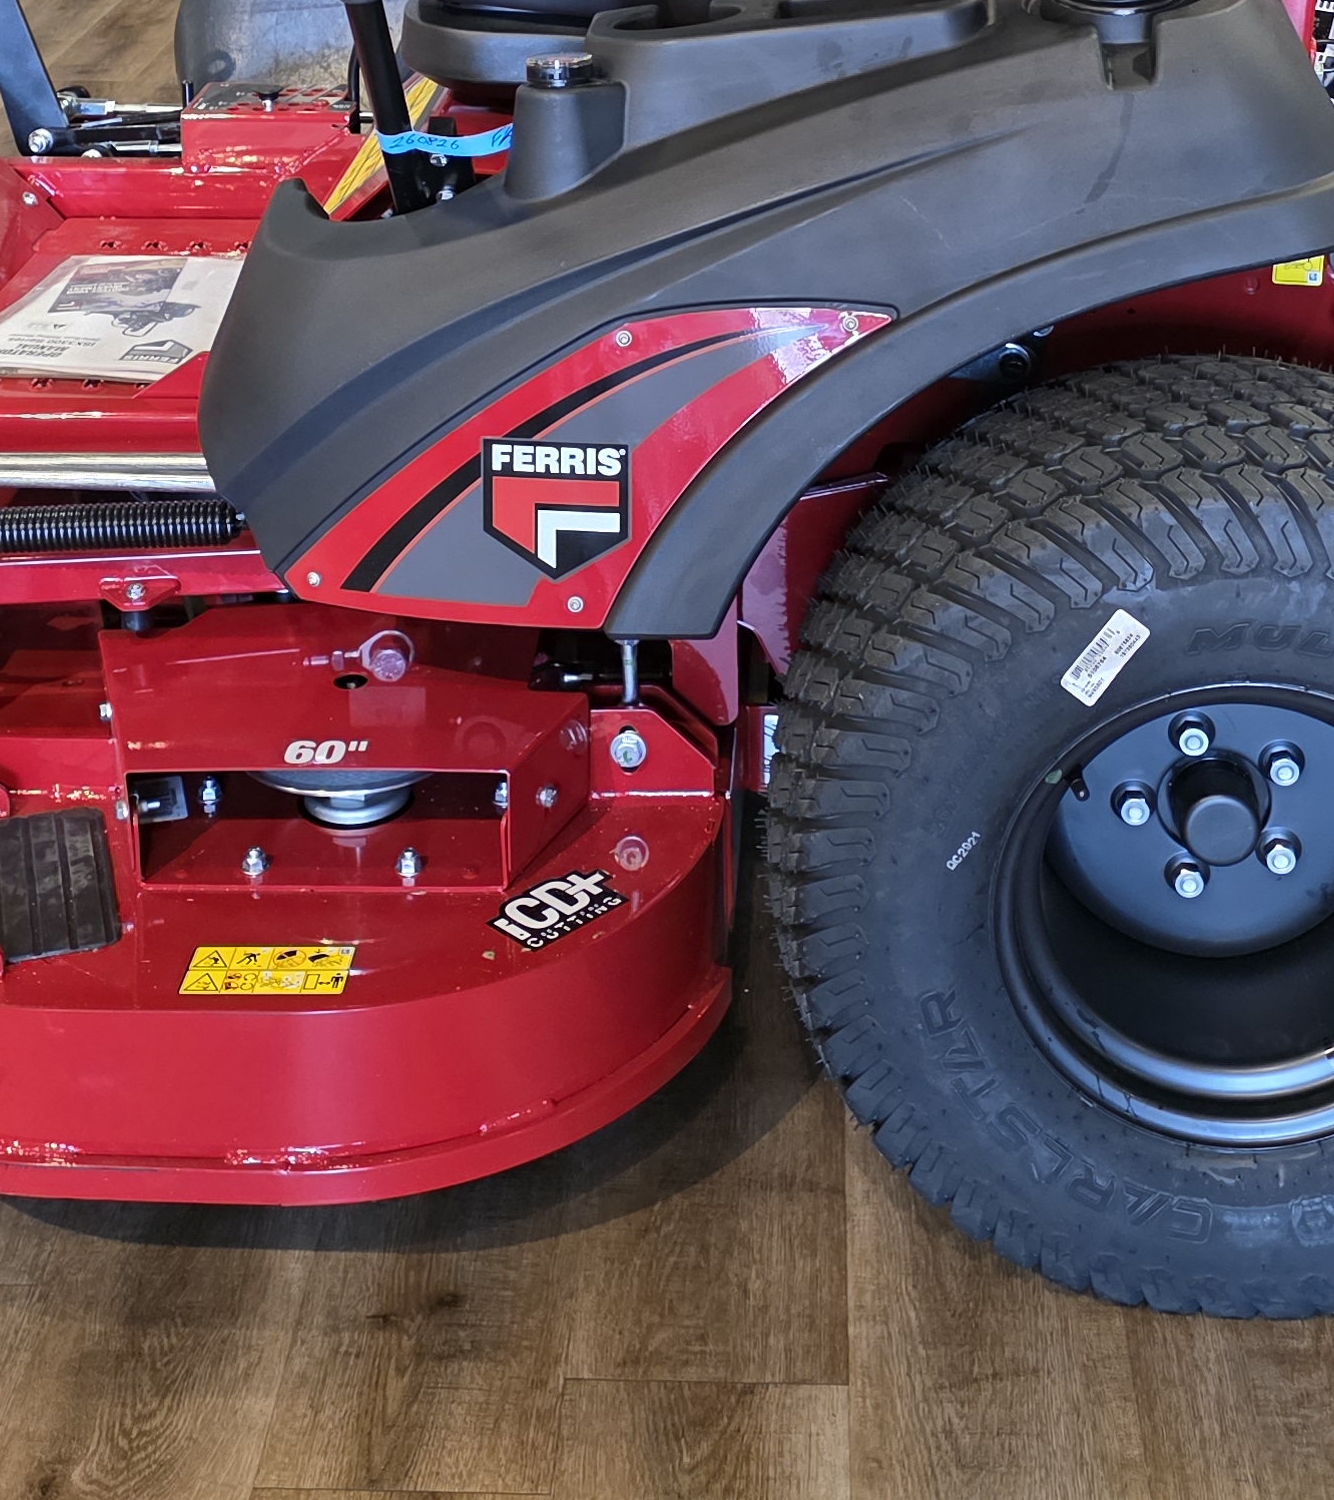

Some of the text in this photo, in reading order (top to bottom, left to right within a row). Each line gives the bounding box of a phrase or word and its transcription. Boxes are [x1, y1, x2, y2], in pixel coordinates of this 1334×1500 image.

[15, 343, 71, 352] MANUAL
[492, 443, 623, 476] FERRIS
[284, 740, 368, 764] 60"
[526, 896, 622, 948] CUTTING
